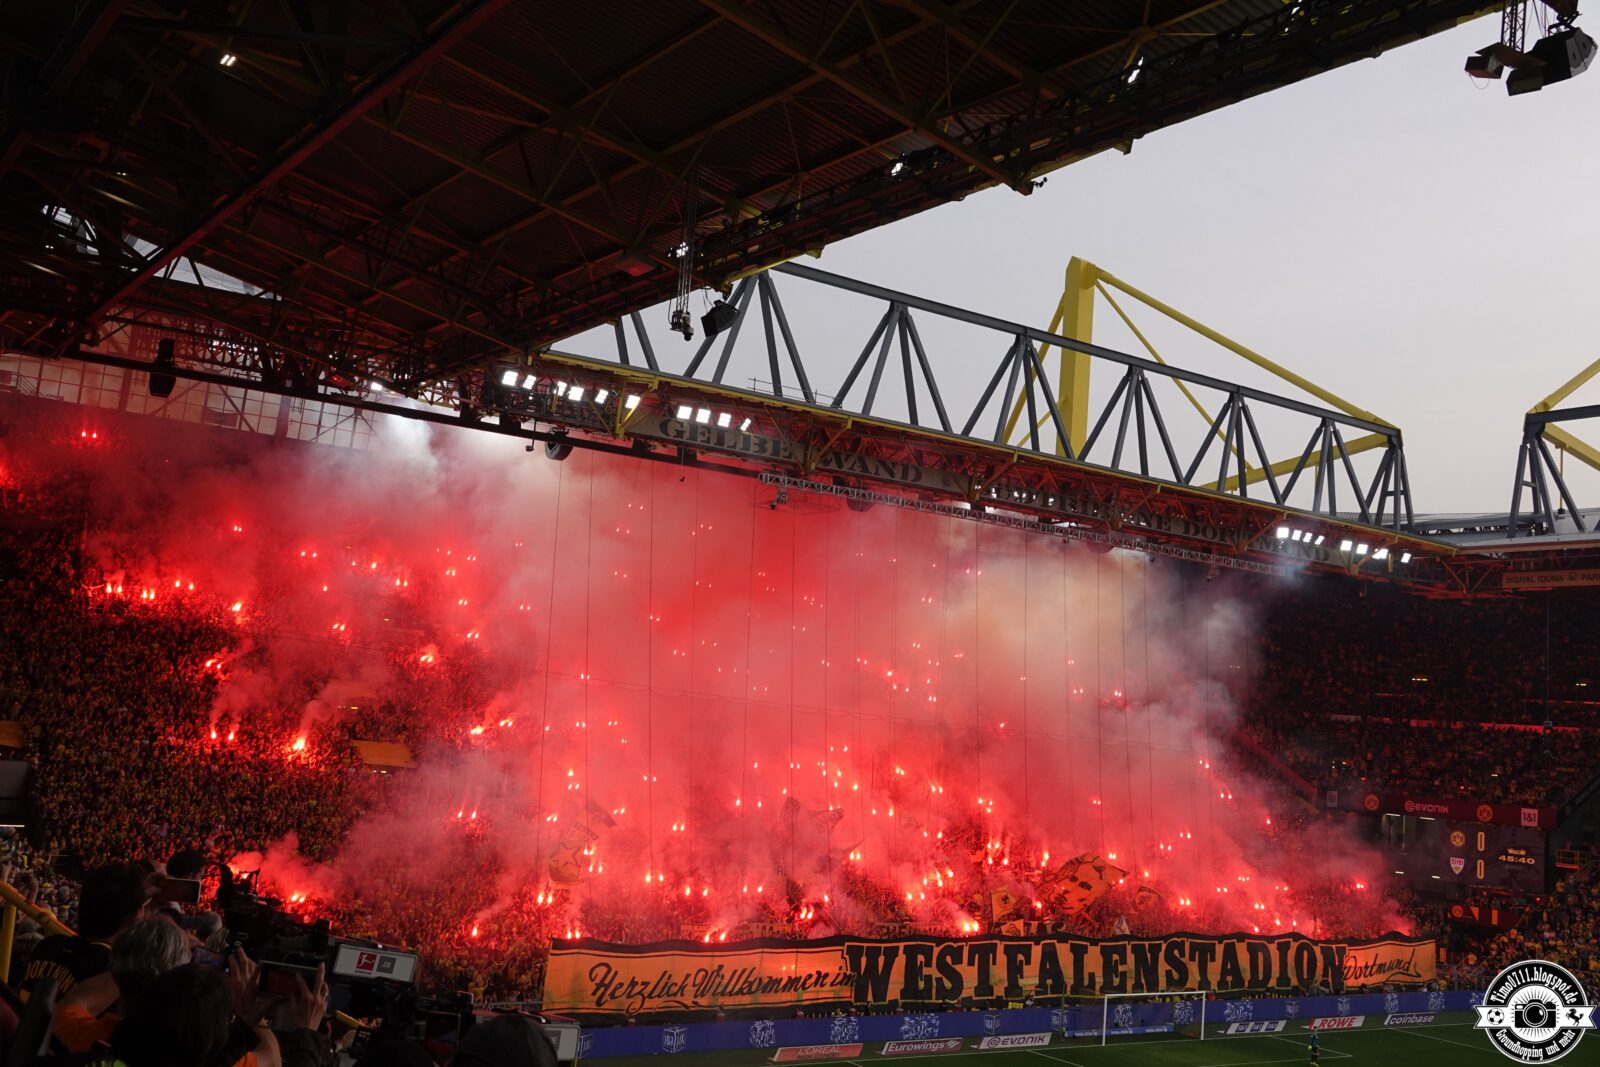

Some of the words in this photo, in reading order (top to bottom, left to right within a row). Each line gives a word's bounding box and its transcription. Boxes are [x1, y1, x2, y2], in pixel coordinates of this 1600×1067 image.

[659, 418, 793, 460] GELBE
[1522, 812, 1537, 822] 1&1
[1497, 854, 1536, 865] 45:40
[1343, 948, 1416, 981] Dortmund
[845, 939, 1347, 1004] WESTFALENSTADION
[588, 962, 692, 1014] Herzlich
[692, 964, 831, 998] Willkommen
[1318, 1016, 1357, 1030] ROWE
[1389, 1013, 1436, 1025] coinbase
[888, 1041, 945, 1052] Eurowings
[1001, 1035, 1046, 1045] EVONIK
